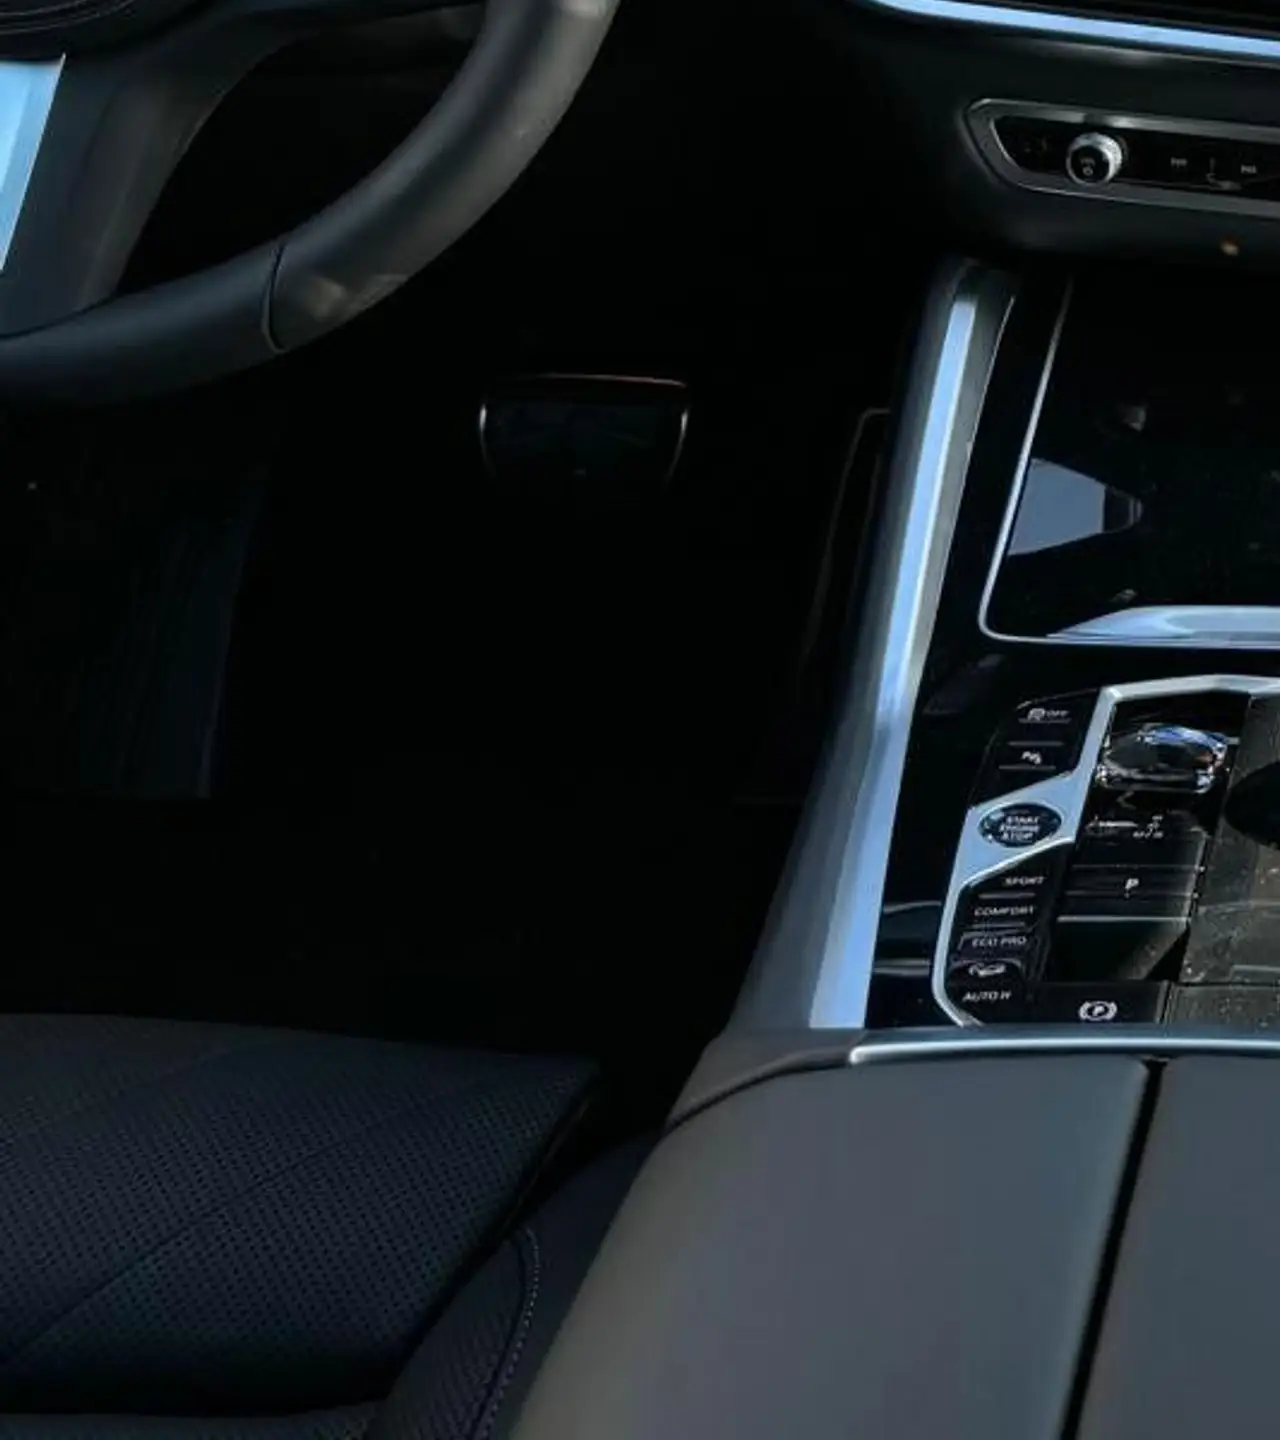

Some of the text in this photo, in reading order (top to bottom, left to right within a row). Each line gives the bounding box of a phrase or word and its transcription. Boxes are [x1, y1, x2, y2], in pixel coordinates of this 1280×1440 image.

[1004, 875, 1046, 886] SPORT
[973, 905, 1035, 917] COMFORT
[1000, 935, 1027, 947] PRO
[961, 990, 999, 1003] AUTO
